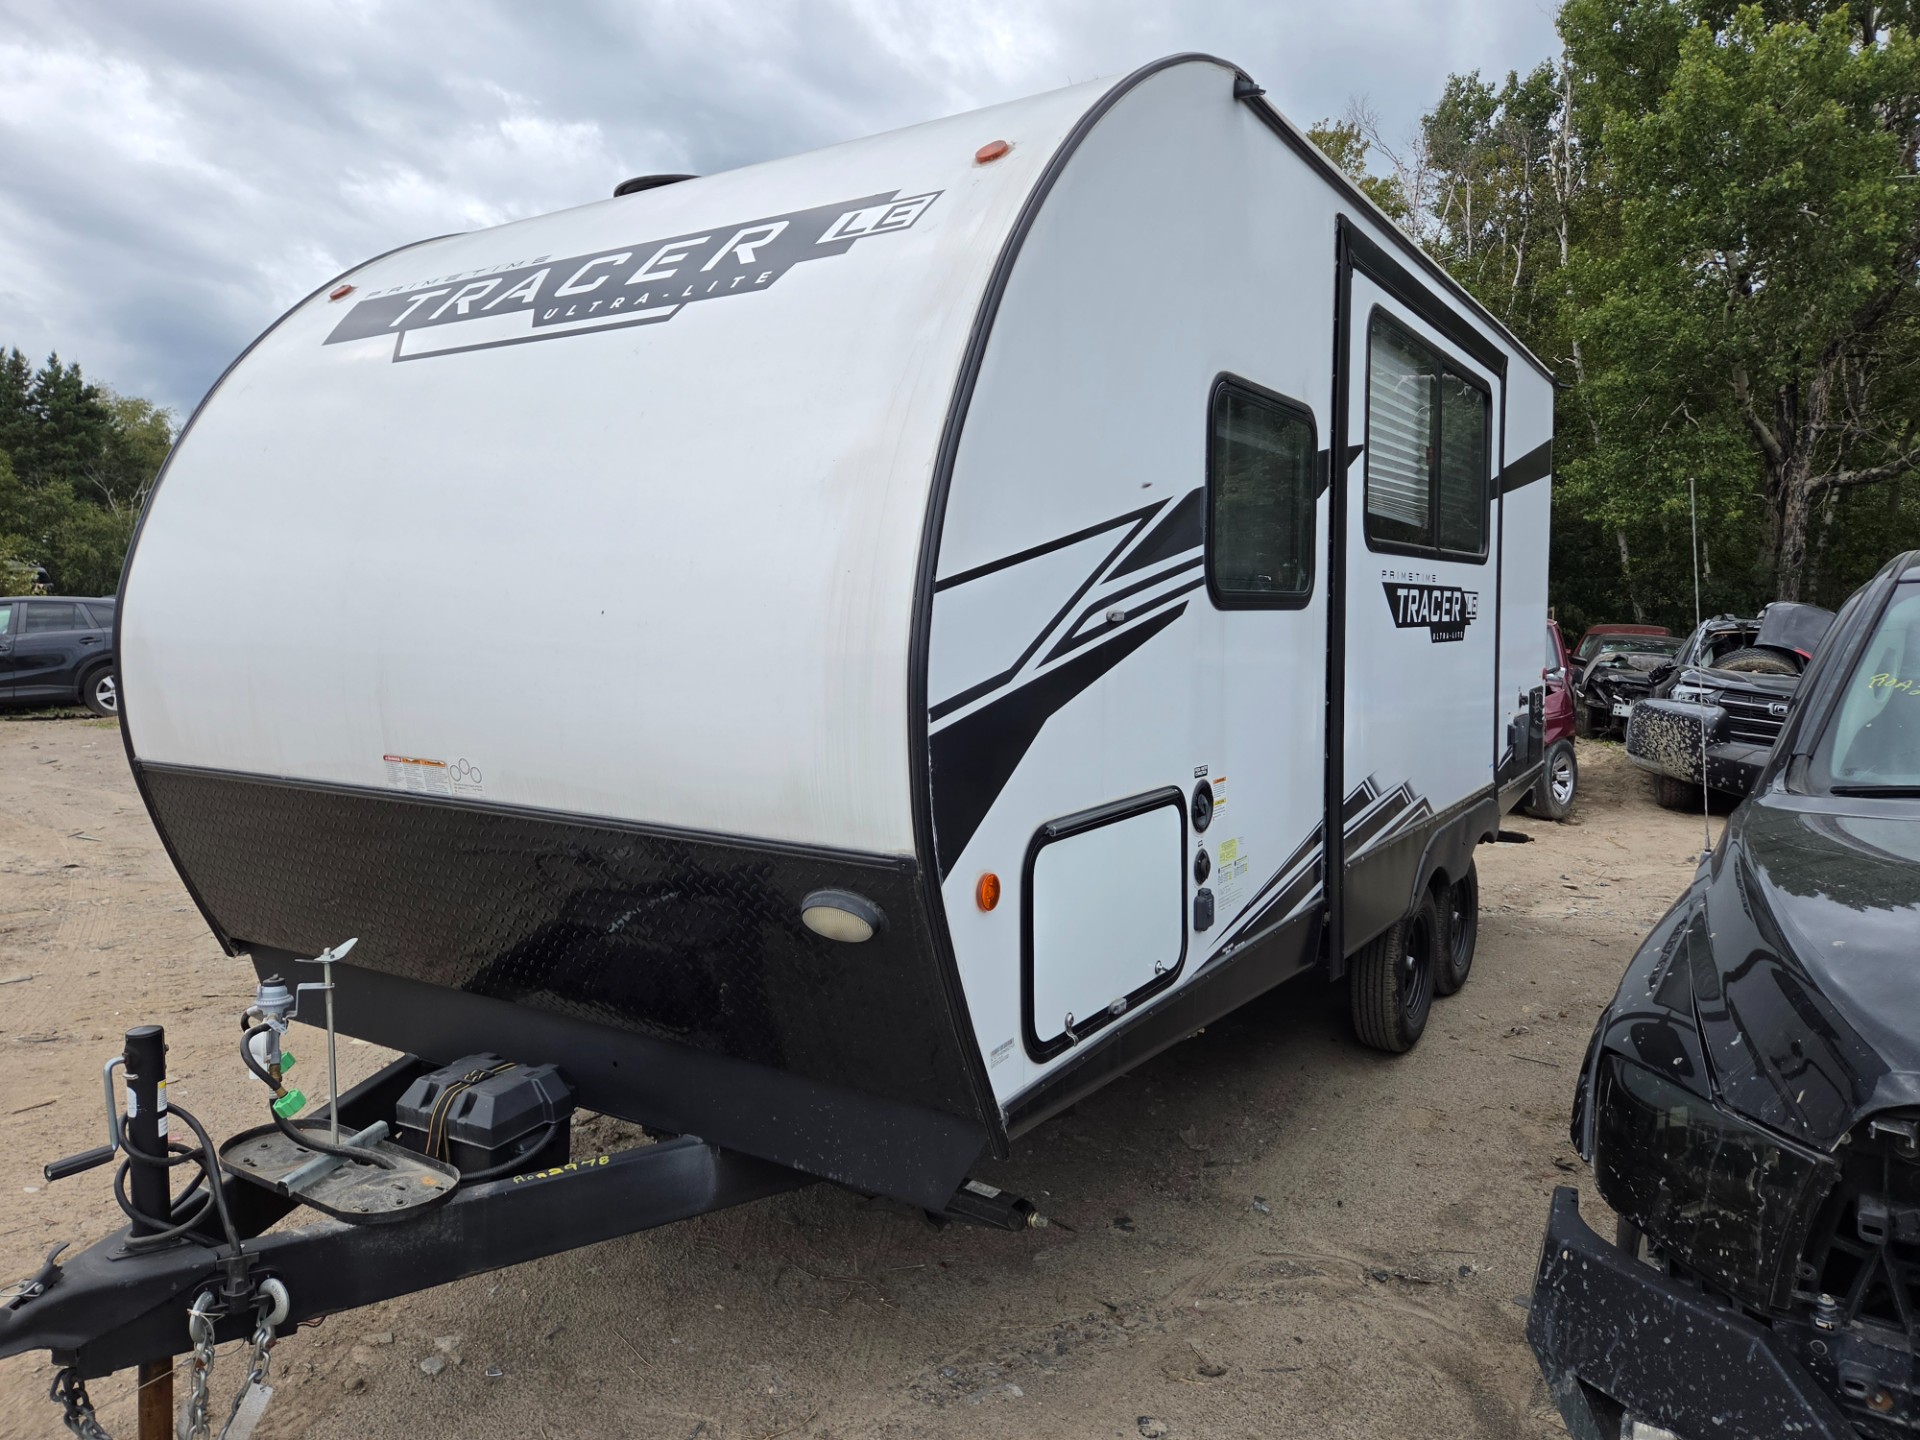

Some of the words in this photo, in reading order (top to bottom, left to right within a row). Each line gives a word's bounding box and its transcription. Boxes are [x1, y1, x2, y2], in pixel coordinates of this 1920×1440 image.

[366, 254, 552, 299] PRIMETIME
[389, 220, 790, 328] TRACER
[831, 198, 927, 239] LE
[543, 270, 773, 321] ULTRA-LITE
[1382, 569, 1437, 582] PRIMETIME
[1396, 587, 1462, 624] TRACER
[1465, 594, 1478, 616] LE
